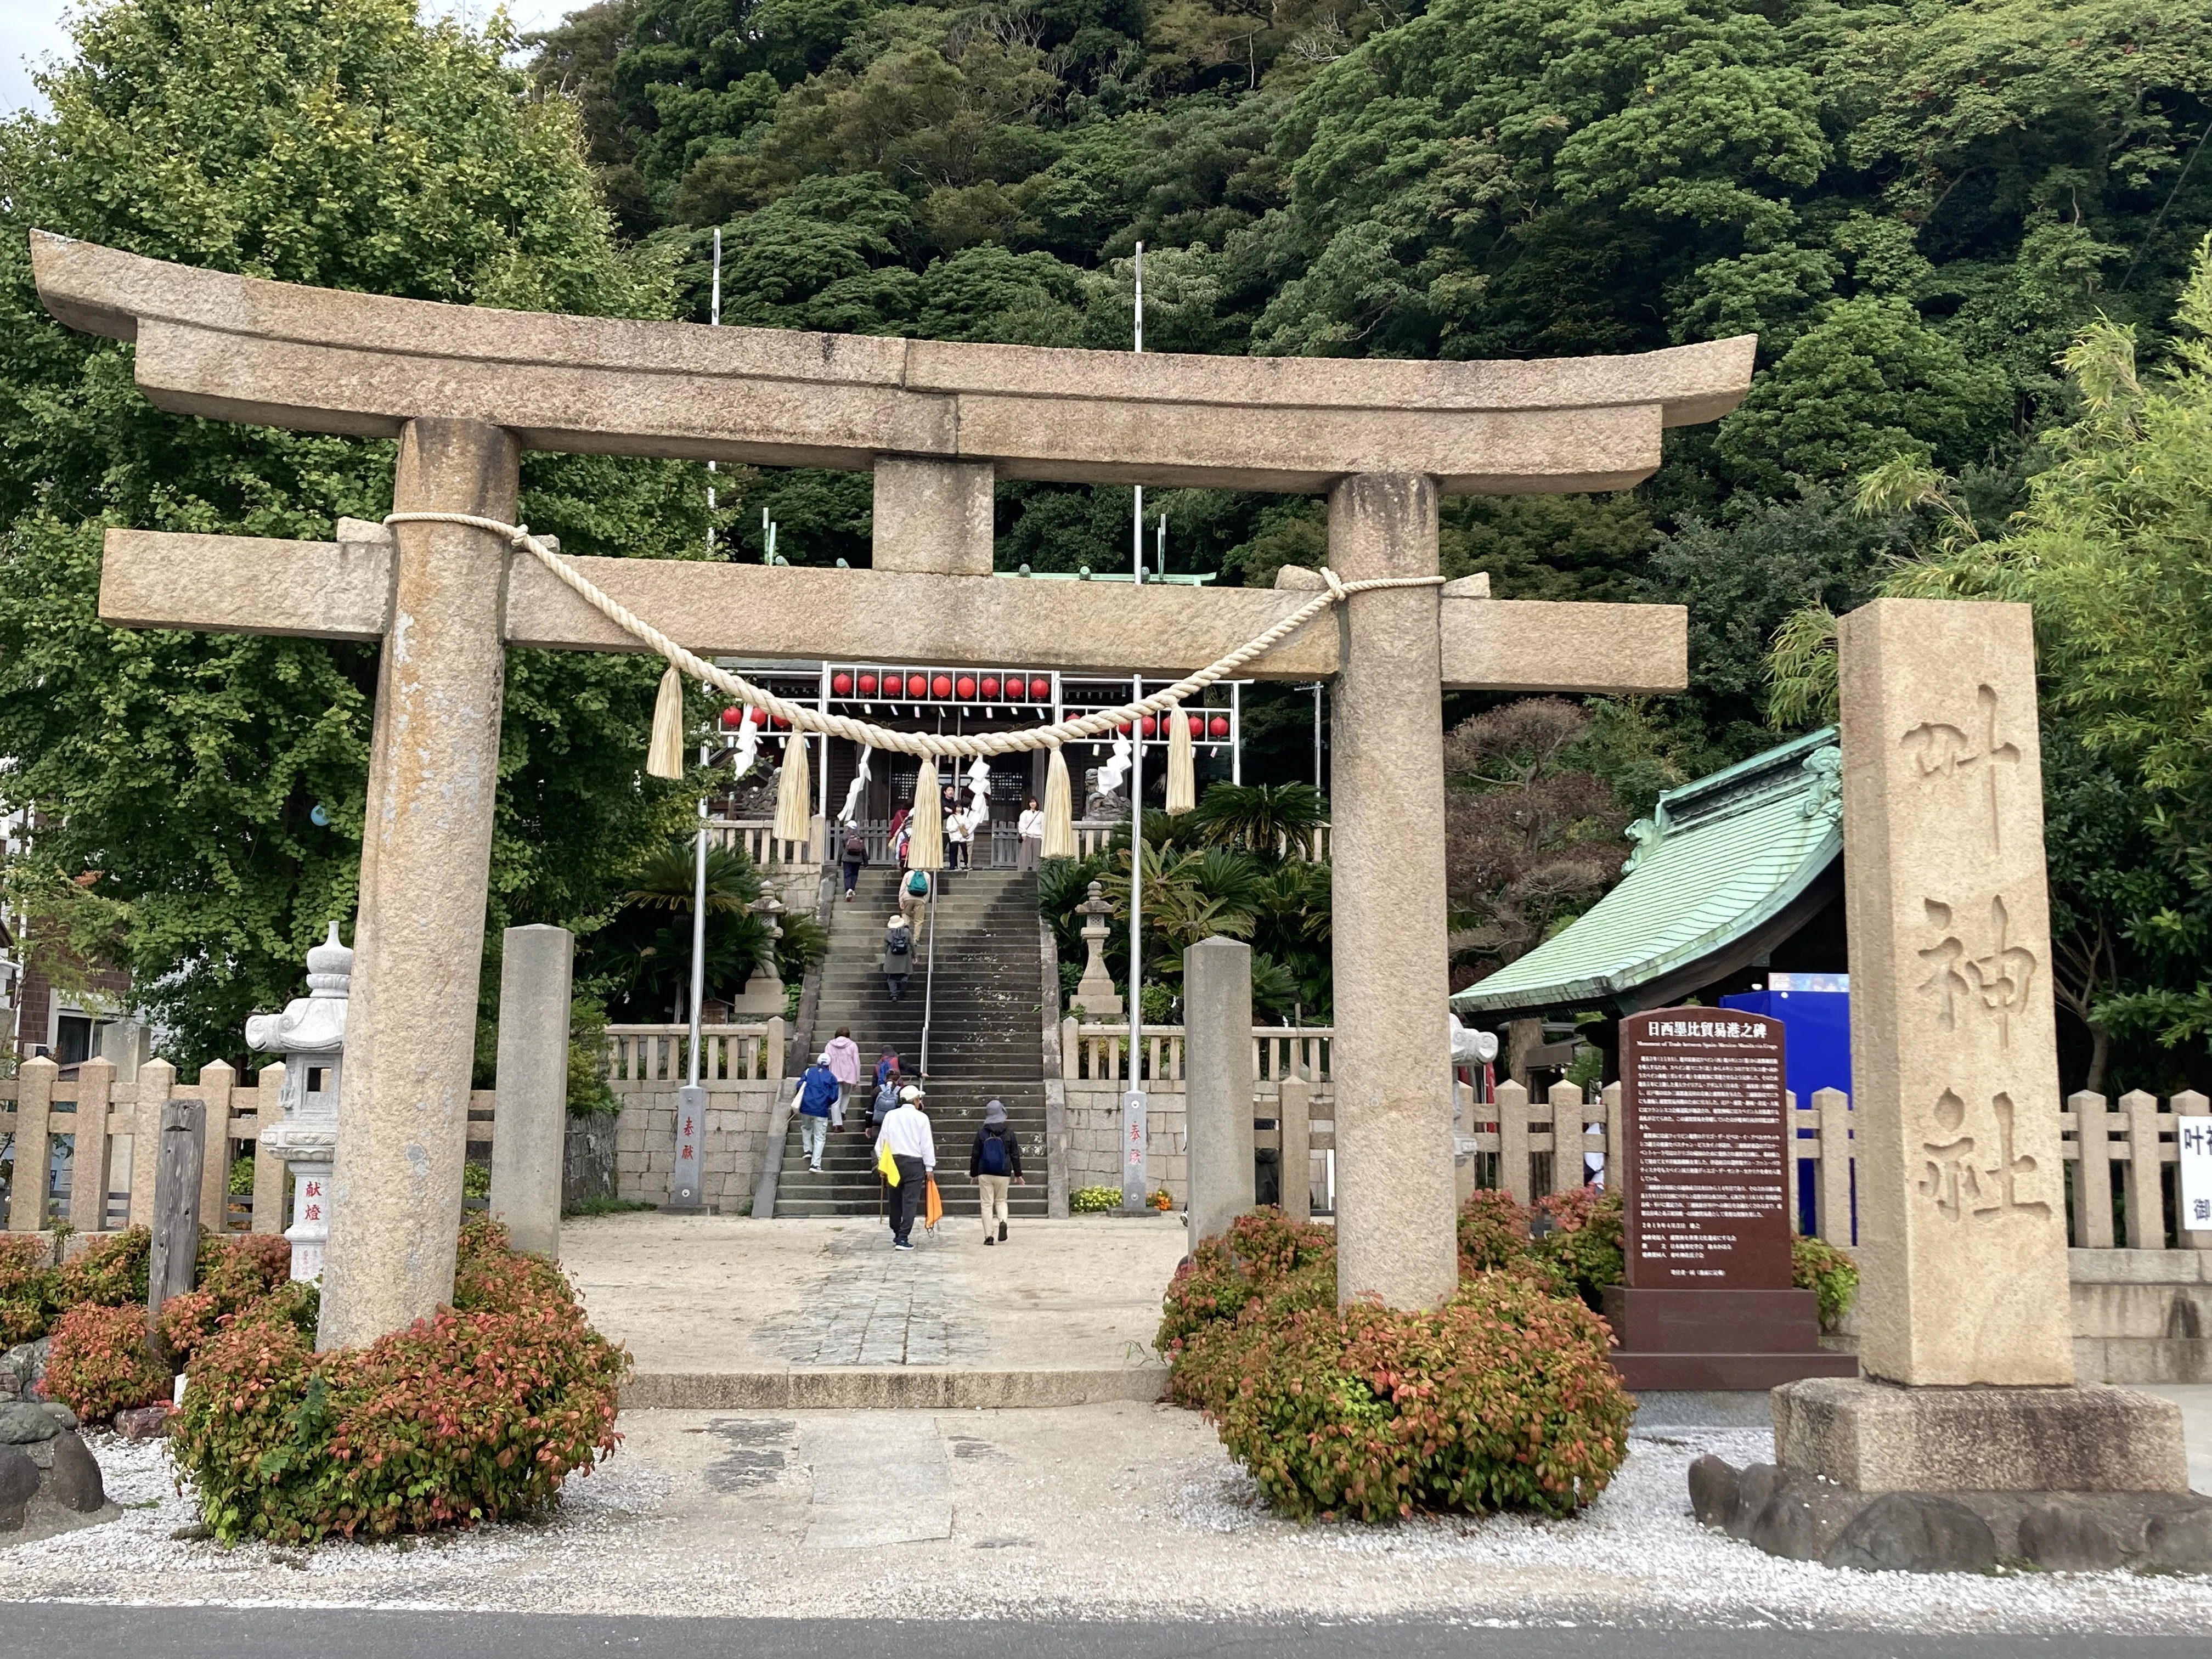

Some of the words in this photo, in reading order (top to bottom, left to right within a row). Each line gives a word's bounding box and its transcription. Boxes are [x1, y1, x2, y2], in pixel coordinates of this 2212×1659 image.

[1648, 1020, 1768, 1039] 日西墨比貿易港之碑
[1900, 682, 2052, 1223] 叶神社
